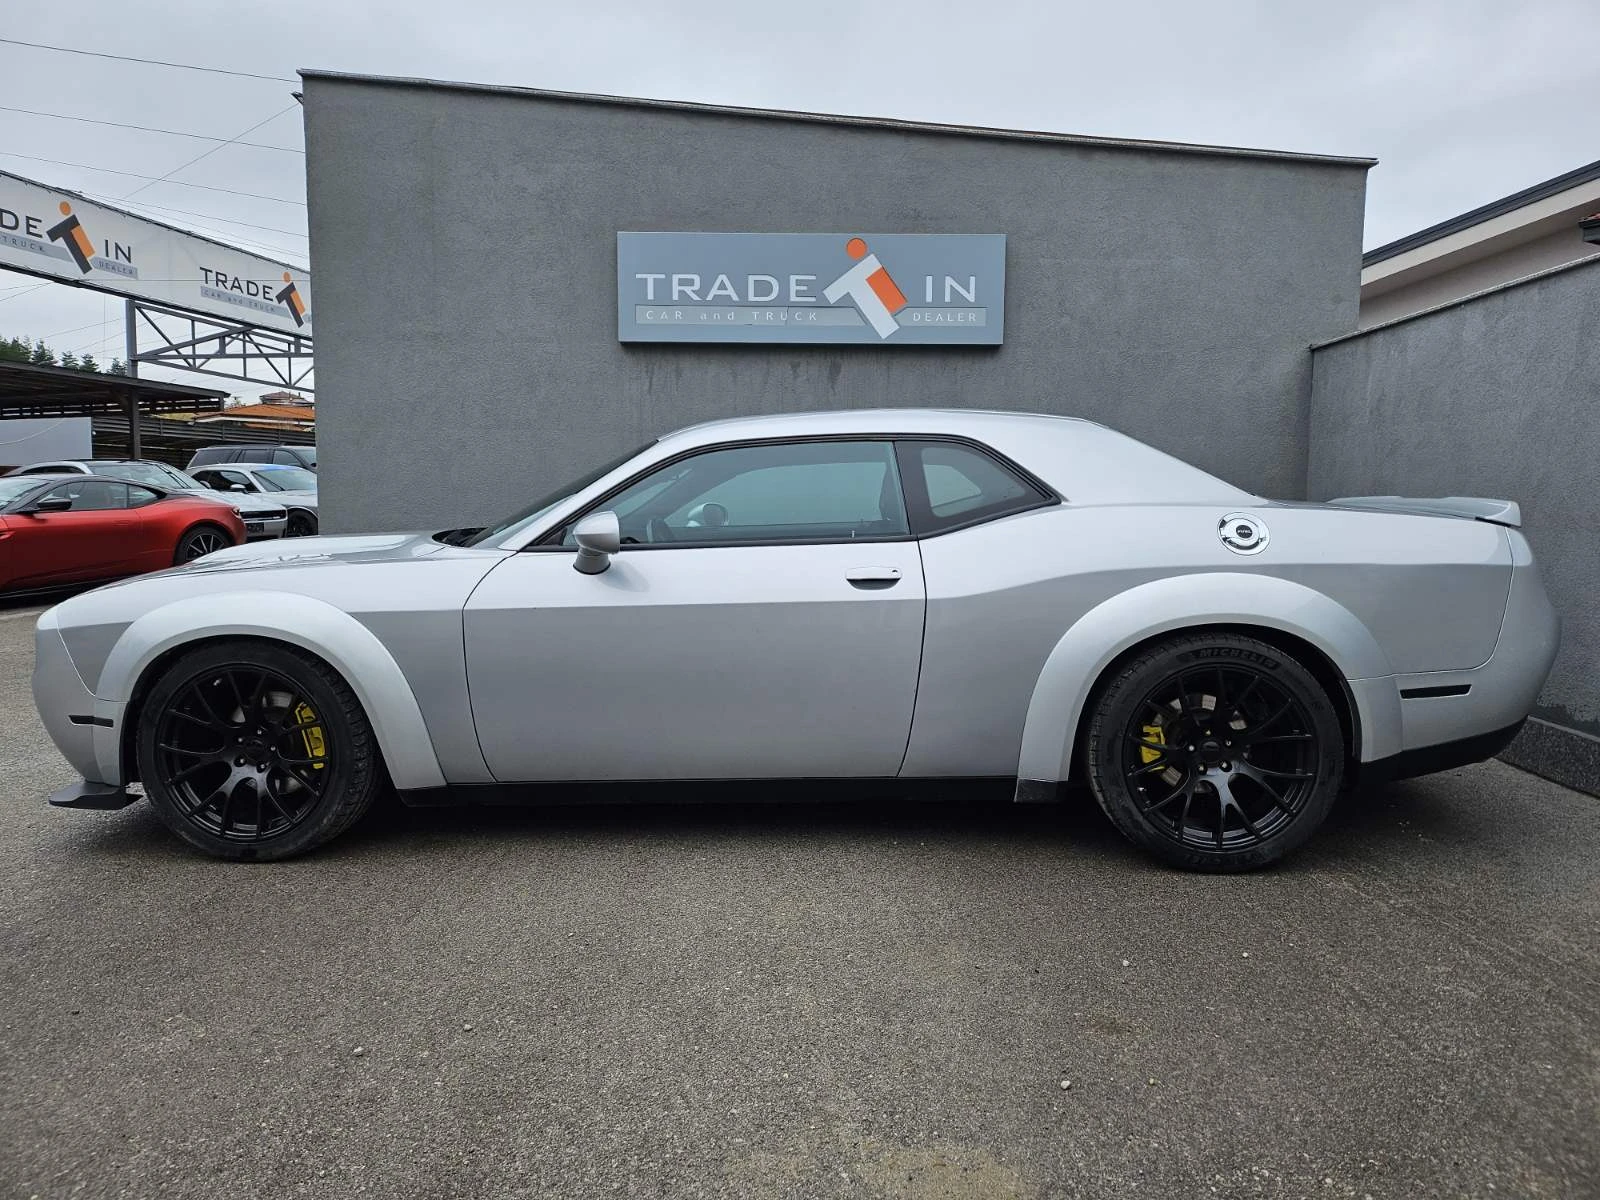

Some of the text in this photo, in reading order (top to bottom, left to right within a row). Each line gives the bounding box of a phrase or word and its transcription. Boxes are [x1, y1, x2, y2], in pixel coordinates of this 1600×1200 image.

[104, 239, 132, 264] IN
[199, 266, 274, 302] TRADE
[635, 273, 817, 302] TRADE
[925, 275, 976, 303] IN
[646, 310, 817, 321] CAR and TRUCK
[912, 312, 977, 322] DEALER
